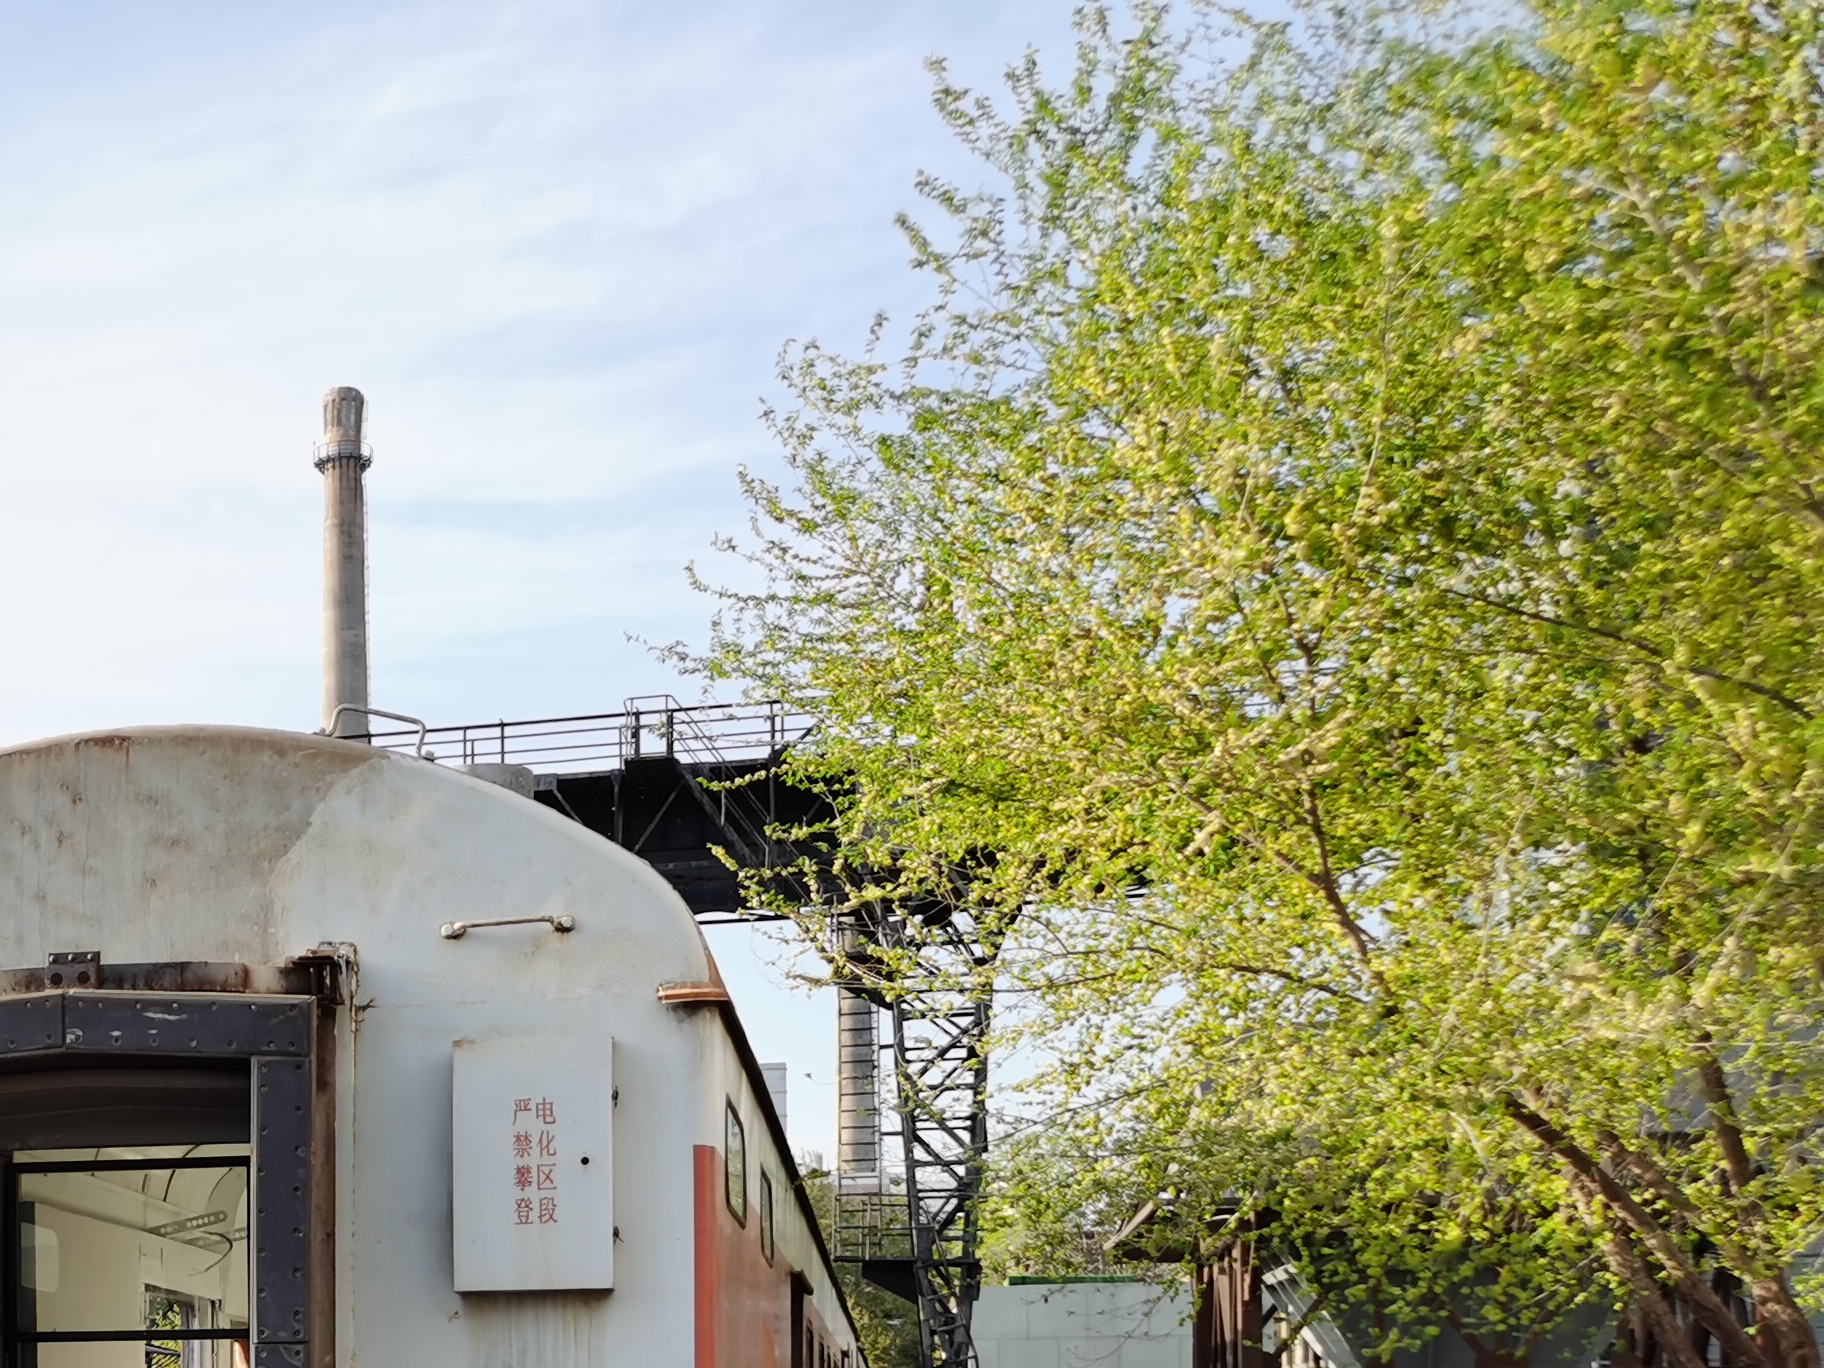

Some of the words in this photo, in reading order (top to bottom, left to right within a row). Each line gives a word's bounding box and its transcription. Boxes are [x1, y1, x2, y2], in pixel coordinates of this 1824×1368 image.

[512, 1097, 534, 1225] 严禁攀登
[535, 1096, 558, 1224] 电化区段
